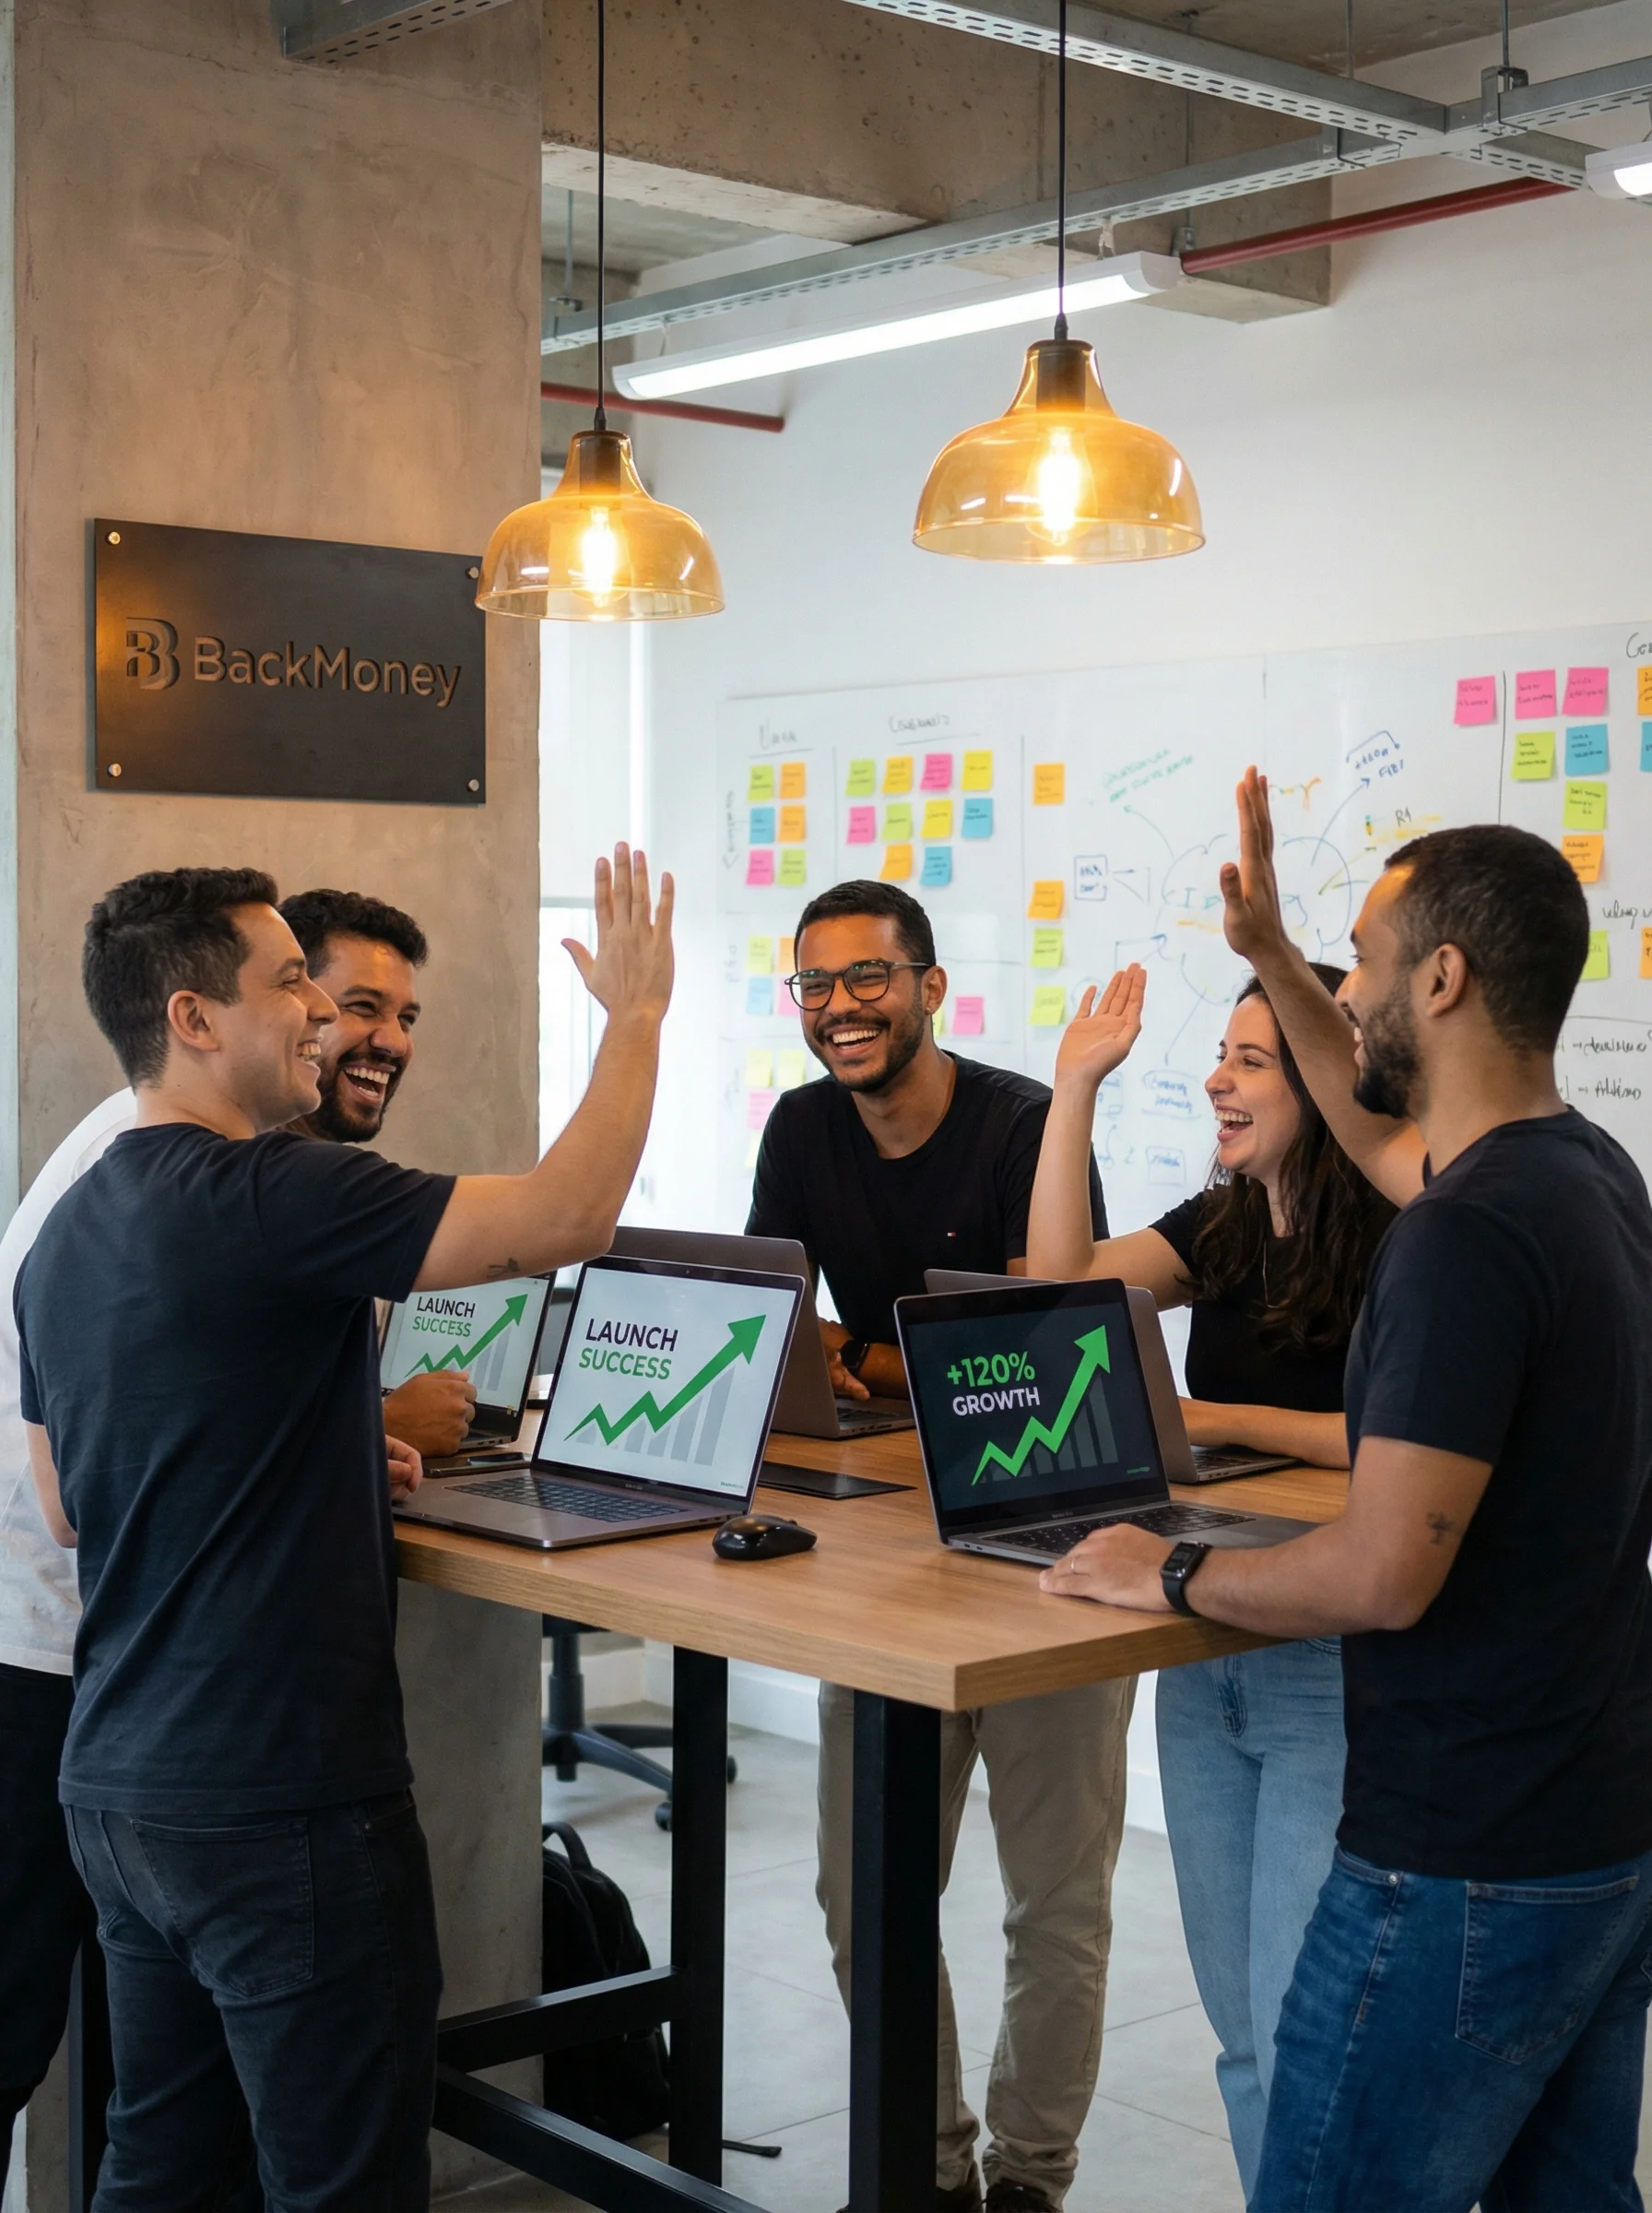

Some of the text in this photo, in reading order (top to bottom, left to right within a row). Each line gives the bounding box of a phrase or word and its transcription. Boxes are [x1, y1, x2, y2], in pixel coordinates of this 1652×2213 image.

[193, 635, 461, 708] BackMoney
[417, 1296, 477, 1319] LAUNCH
[585, 1318, 678, 1352] LAUNCH
[578, 1347, 672, 1380] SUCCESS
[947, 1351, 1035, 1388] +120%
[952, 1386, 1041, 1416] GROWTH
